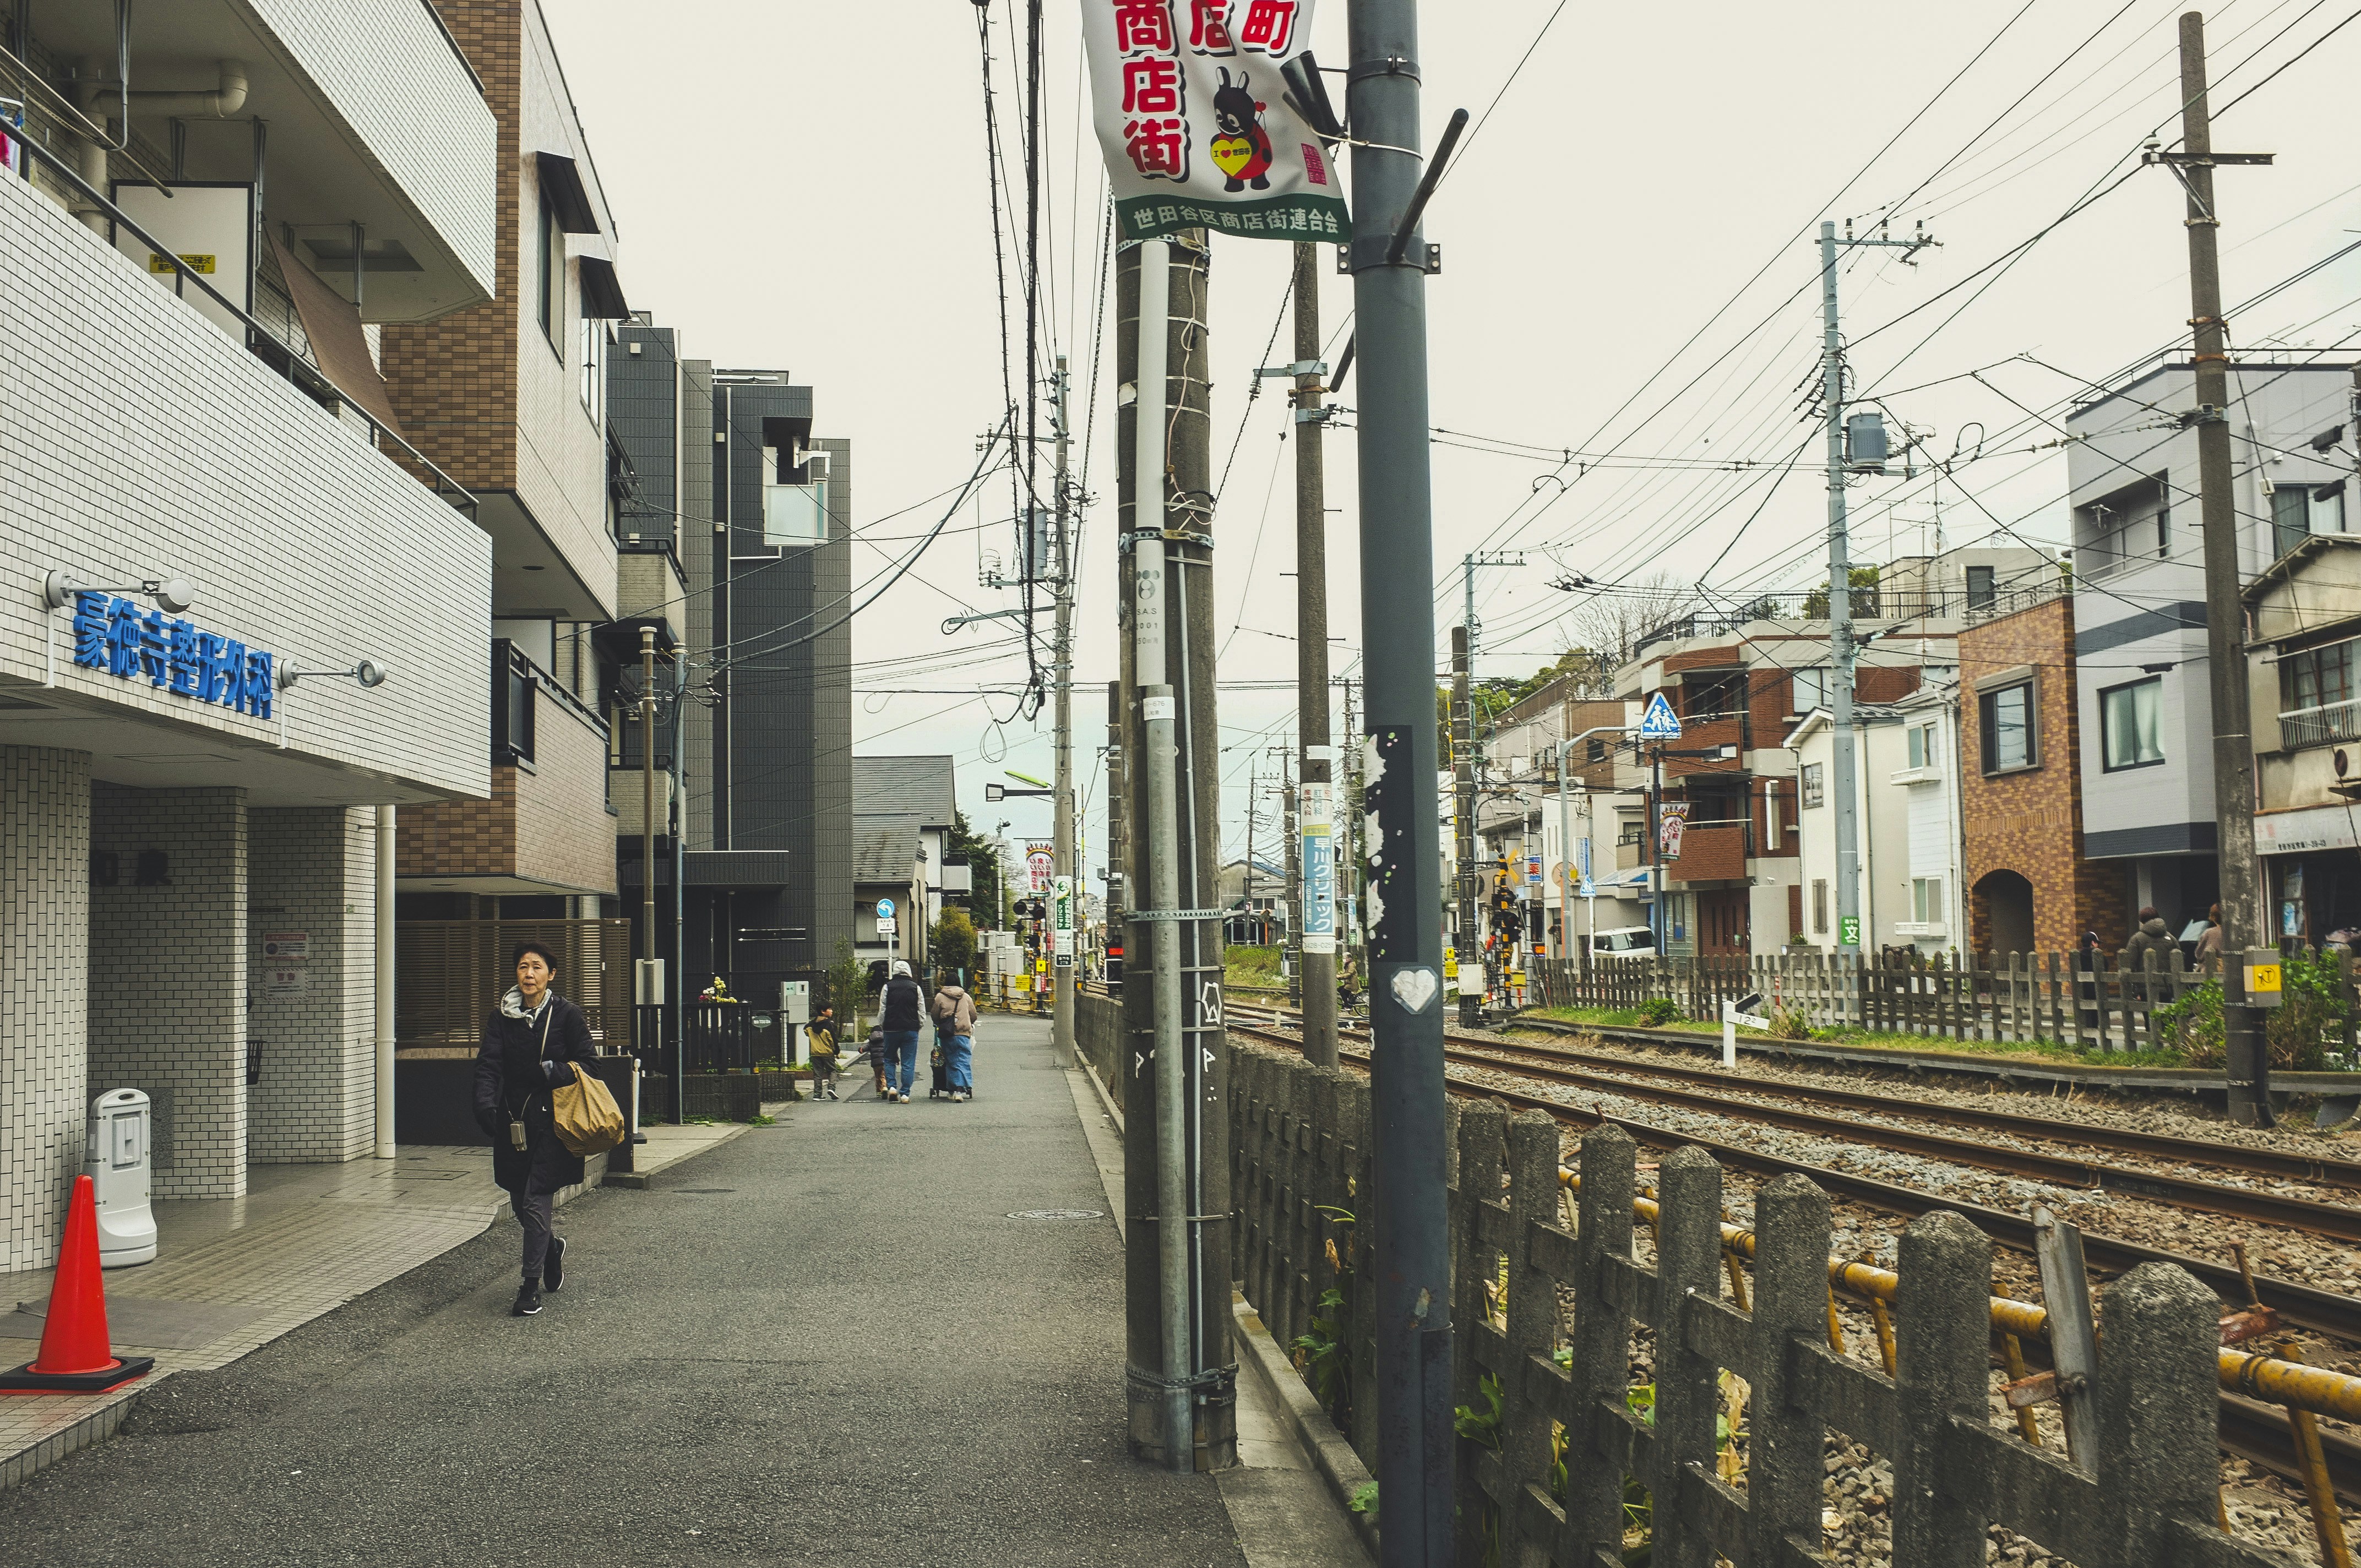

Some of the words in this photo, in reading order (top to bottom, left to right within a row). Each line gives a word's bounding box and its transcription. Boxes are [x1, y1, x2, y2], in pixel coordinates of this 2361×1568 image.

[1133, 204, 1339, 235] 世田谷区商店街連合会
[73, 591, 273, 720] 豪徳寺整形外科
[1313, 837, 1331, 932] 早川クリニック
